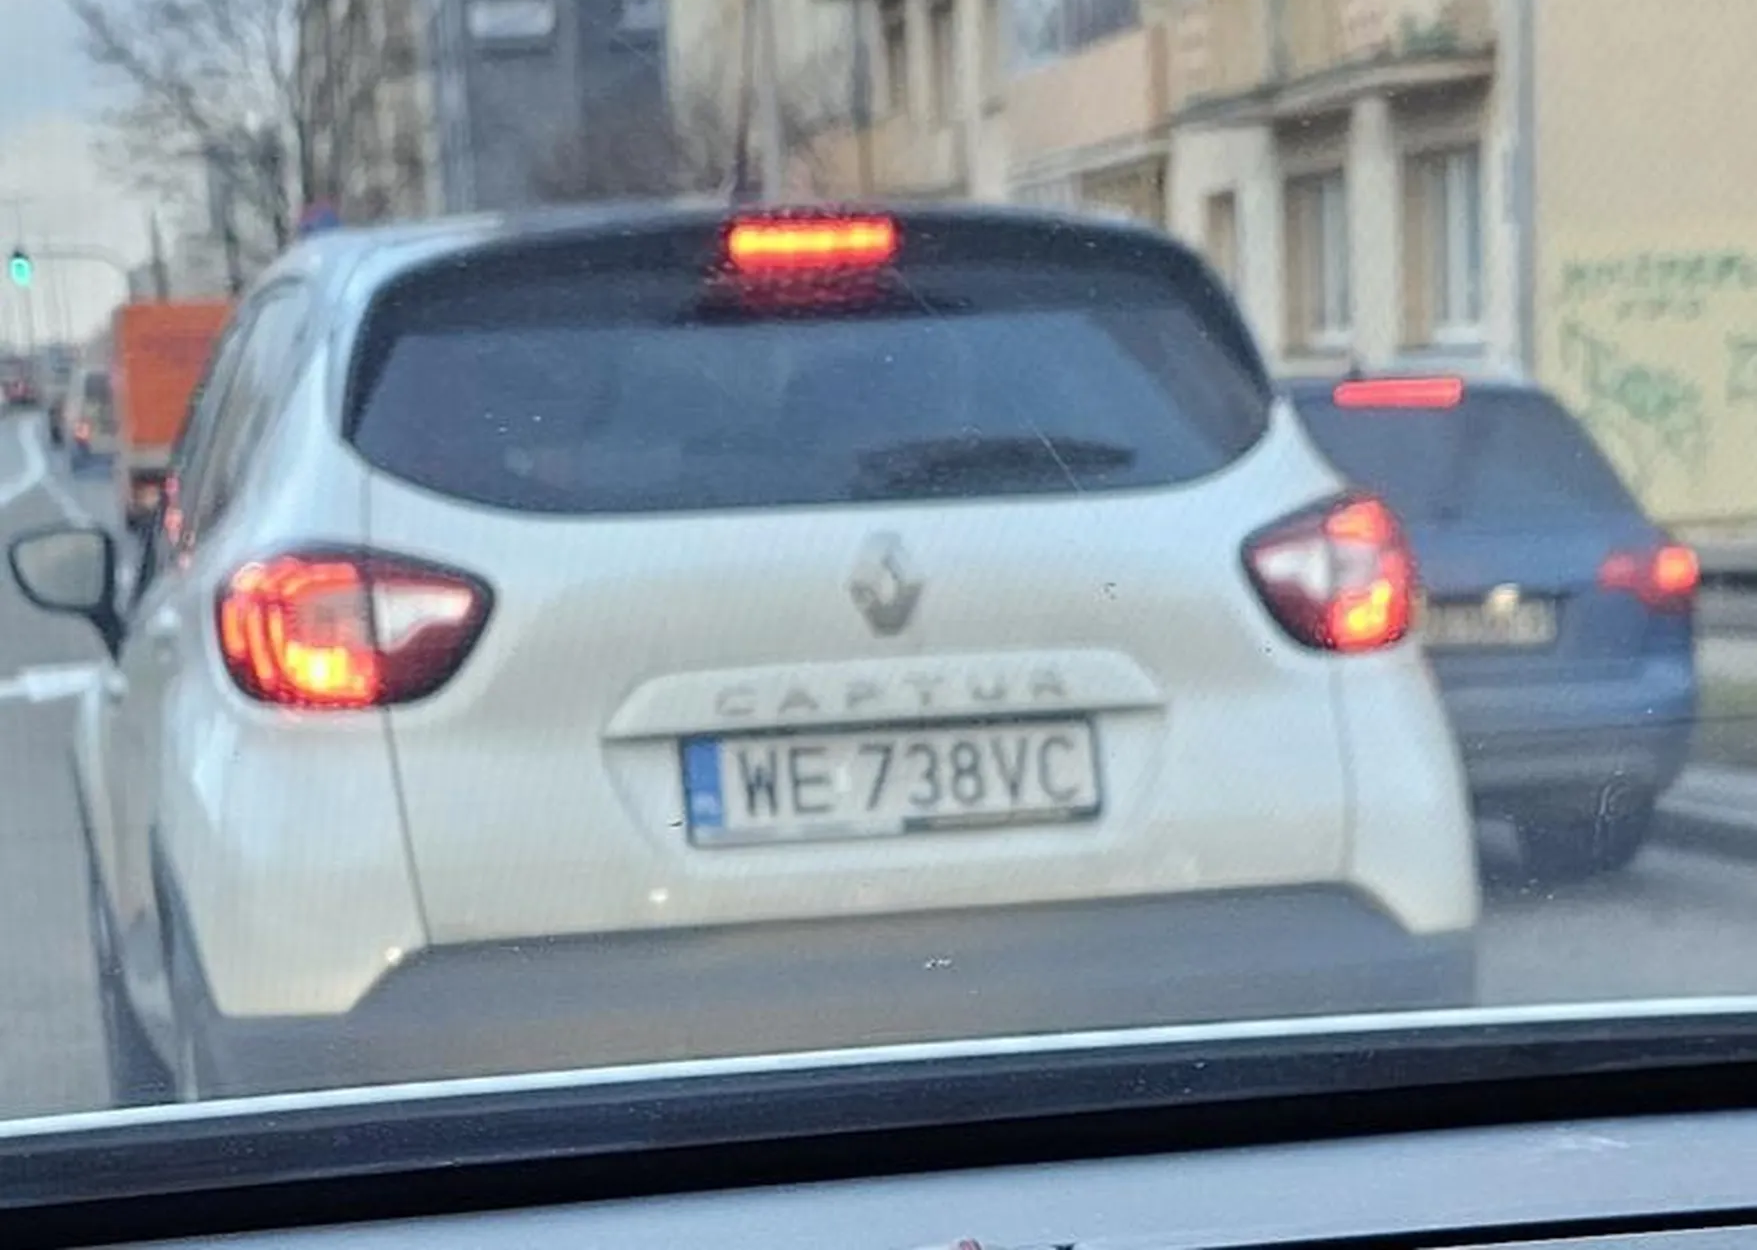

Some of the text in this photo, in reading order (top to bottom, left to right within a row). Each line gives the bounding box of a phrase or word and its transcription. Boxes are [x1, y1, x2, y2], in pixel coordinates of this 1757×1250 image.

[715, 668, 1068, 717] CAPTUR
[738, 736, 1080, 817] WE 738VC
